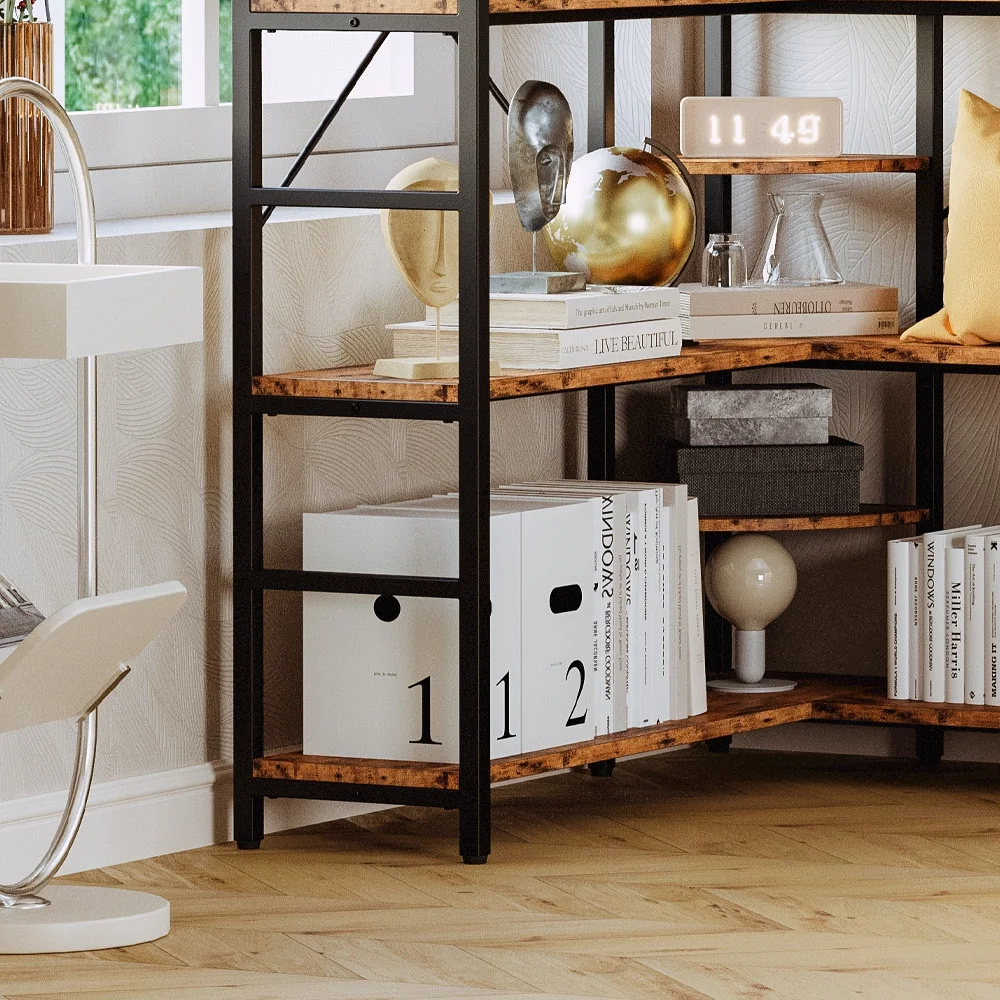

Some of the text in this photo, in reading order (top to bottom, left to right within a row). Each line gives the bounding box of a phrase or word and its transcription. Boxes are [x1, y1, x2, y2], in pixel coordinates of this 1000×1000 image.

[764, 320, 793, 330] CEREAL
[774, 300, 832, 314] OTTOBEUREN
[594, 337, 619, 354] LIVE
[621, 330, 678, 352] BEAUTIFUL
[951, 582, 961, 679] Miller Harris
[992, 643, 997, 653] IT
[408, 675, 442, 745] 1
[496, 670, 516, 740] 1
[566, 659, 588, 727] 2
